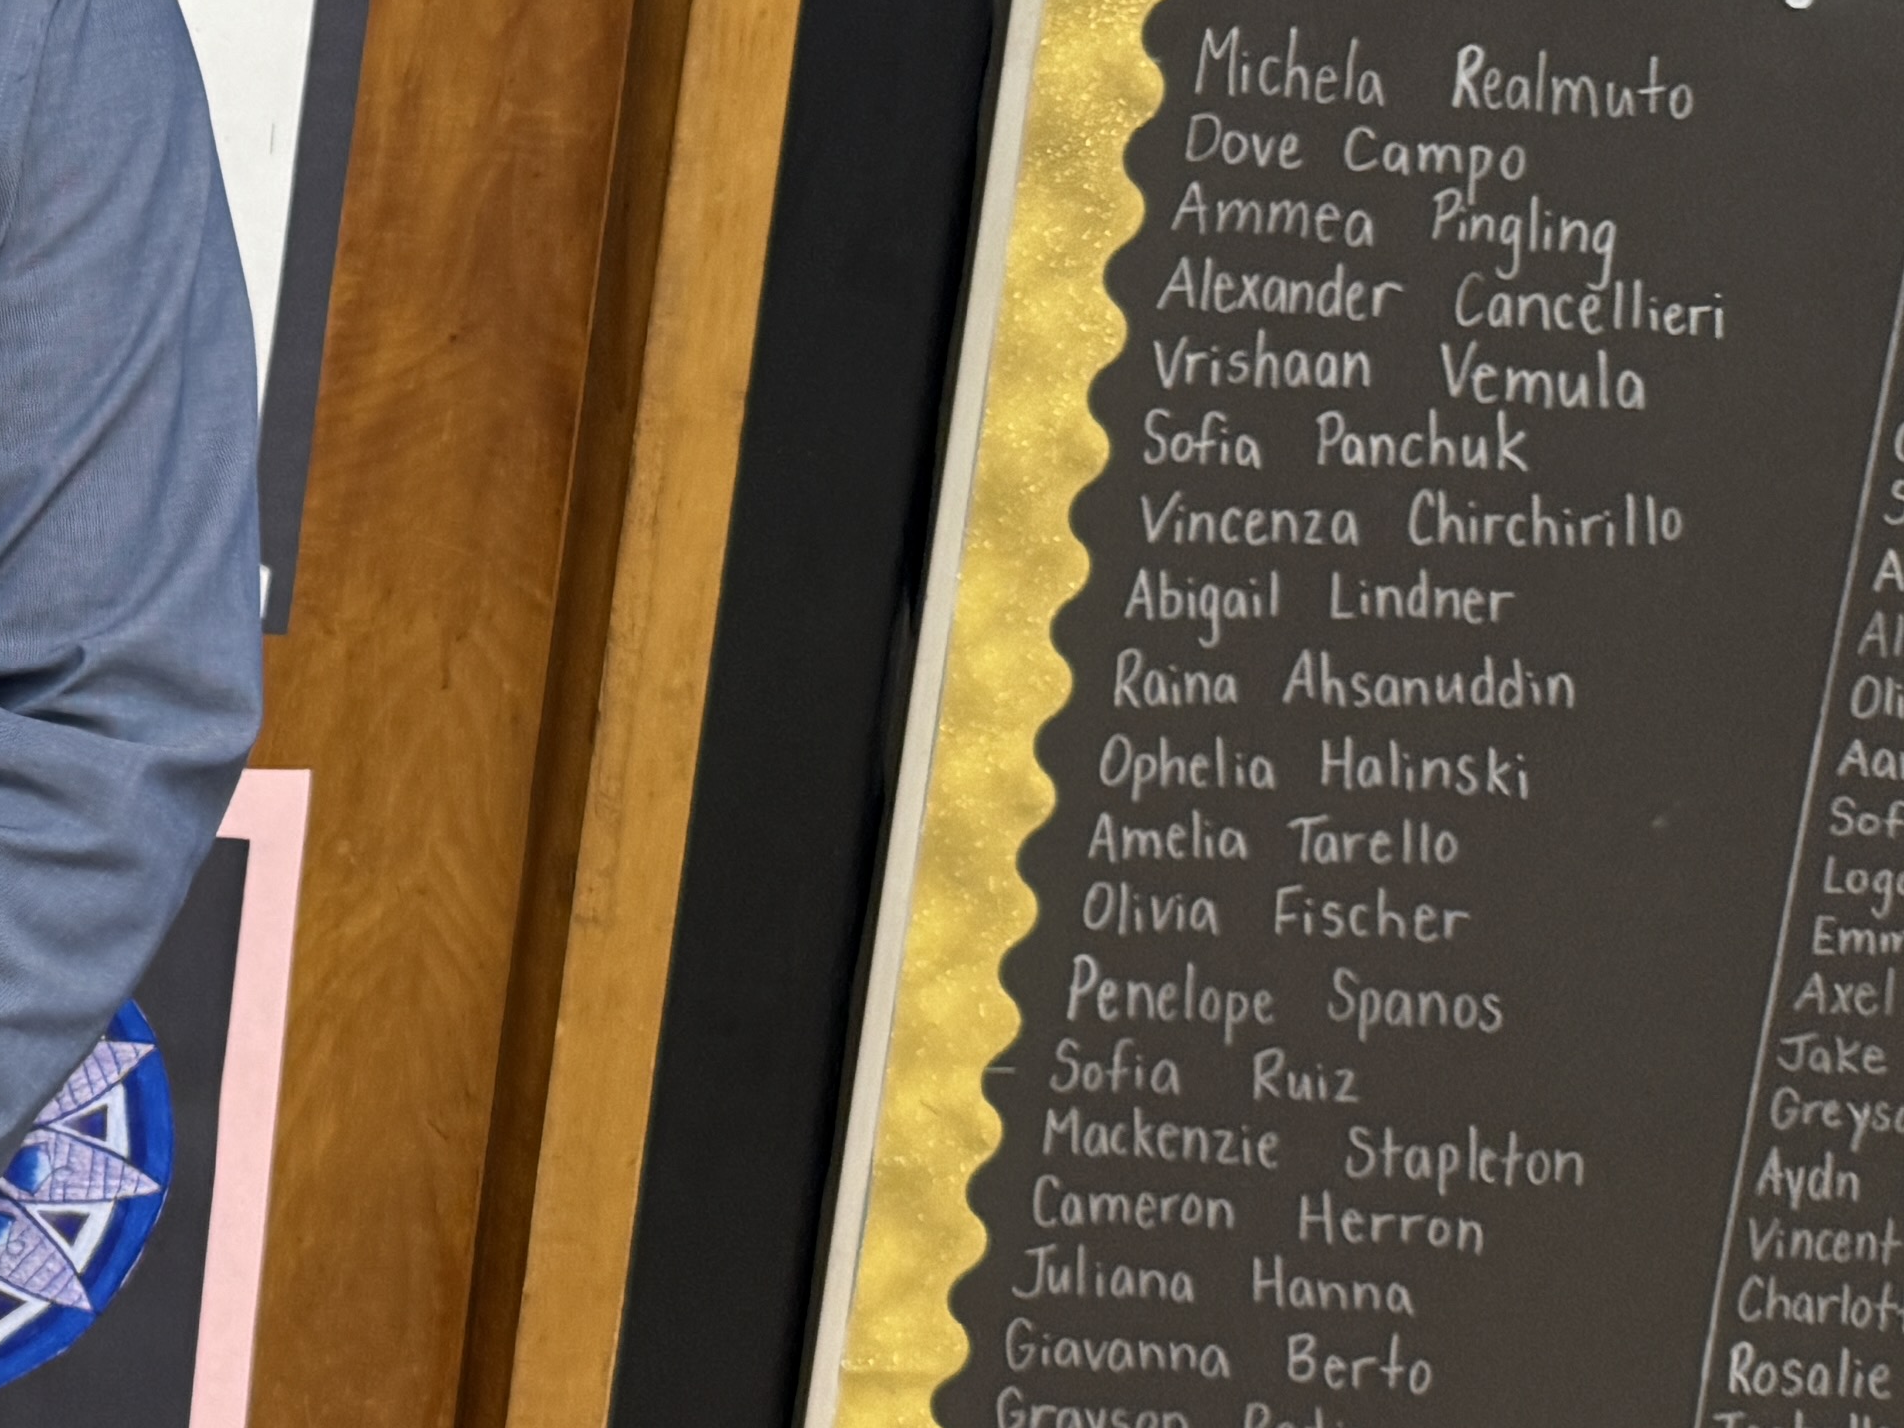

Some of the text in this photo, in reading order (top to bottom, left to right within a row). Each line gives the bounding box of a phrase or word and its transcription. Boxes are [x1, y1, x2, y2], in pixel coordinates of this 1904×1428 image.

[1193, 24, 1695, 121] Michela Realmuto
[1184, 111, 1528, 207] Dove Campo
[1169, 179, 1619, 290] Ammea Pingling
[1155, 255, 1726, 341] Alexander Cancellieri
[1152, 327, 1647, 411] Vrishaan Vemula
[1142, 406, 1530, 473] Sofia Panchuk
[1139, 487, 1684, 549] Vincenza Chirchirillo
[1123, 566, 1516, 650] Abigail Lindner
[1112, 646, 1577, 710] Raina Ahsanuddin
[1098, 732, 1530, 803] Ophelia Halinski
[1086, 808, 1460, 866] Amelia Tarello
[1082, 880, 1471, 944] Olivia Fischer
[1065, 952, 1504, 1046] Penelope Spanos
[1792, 966, 1896, 1018] Axel
[1049, 1036, 1359, 1104] Sofia Ruiz
[1776, 1031, 1888, 1076] Jake
[1041, 1105, 1586, 1198] Mackenzie Stapleton
[1031, 1173, 1485, 1256] Cameron Herron
[1748, 1217, 1903, 1266] Vincent
[1010, 1242, 1416, 1317] Juliana Hanna
[1004, 1316, 1434, 1396] Giavanna Berto
[1727, 1339, 1892, 1401] Rosalie
